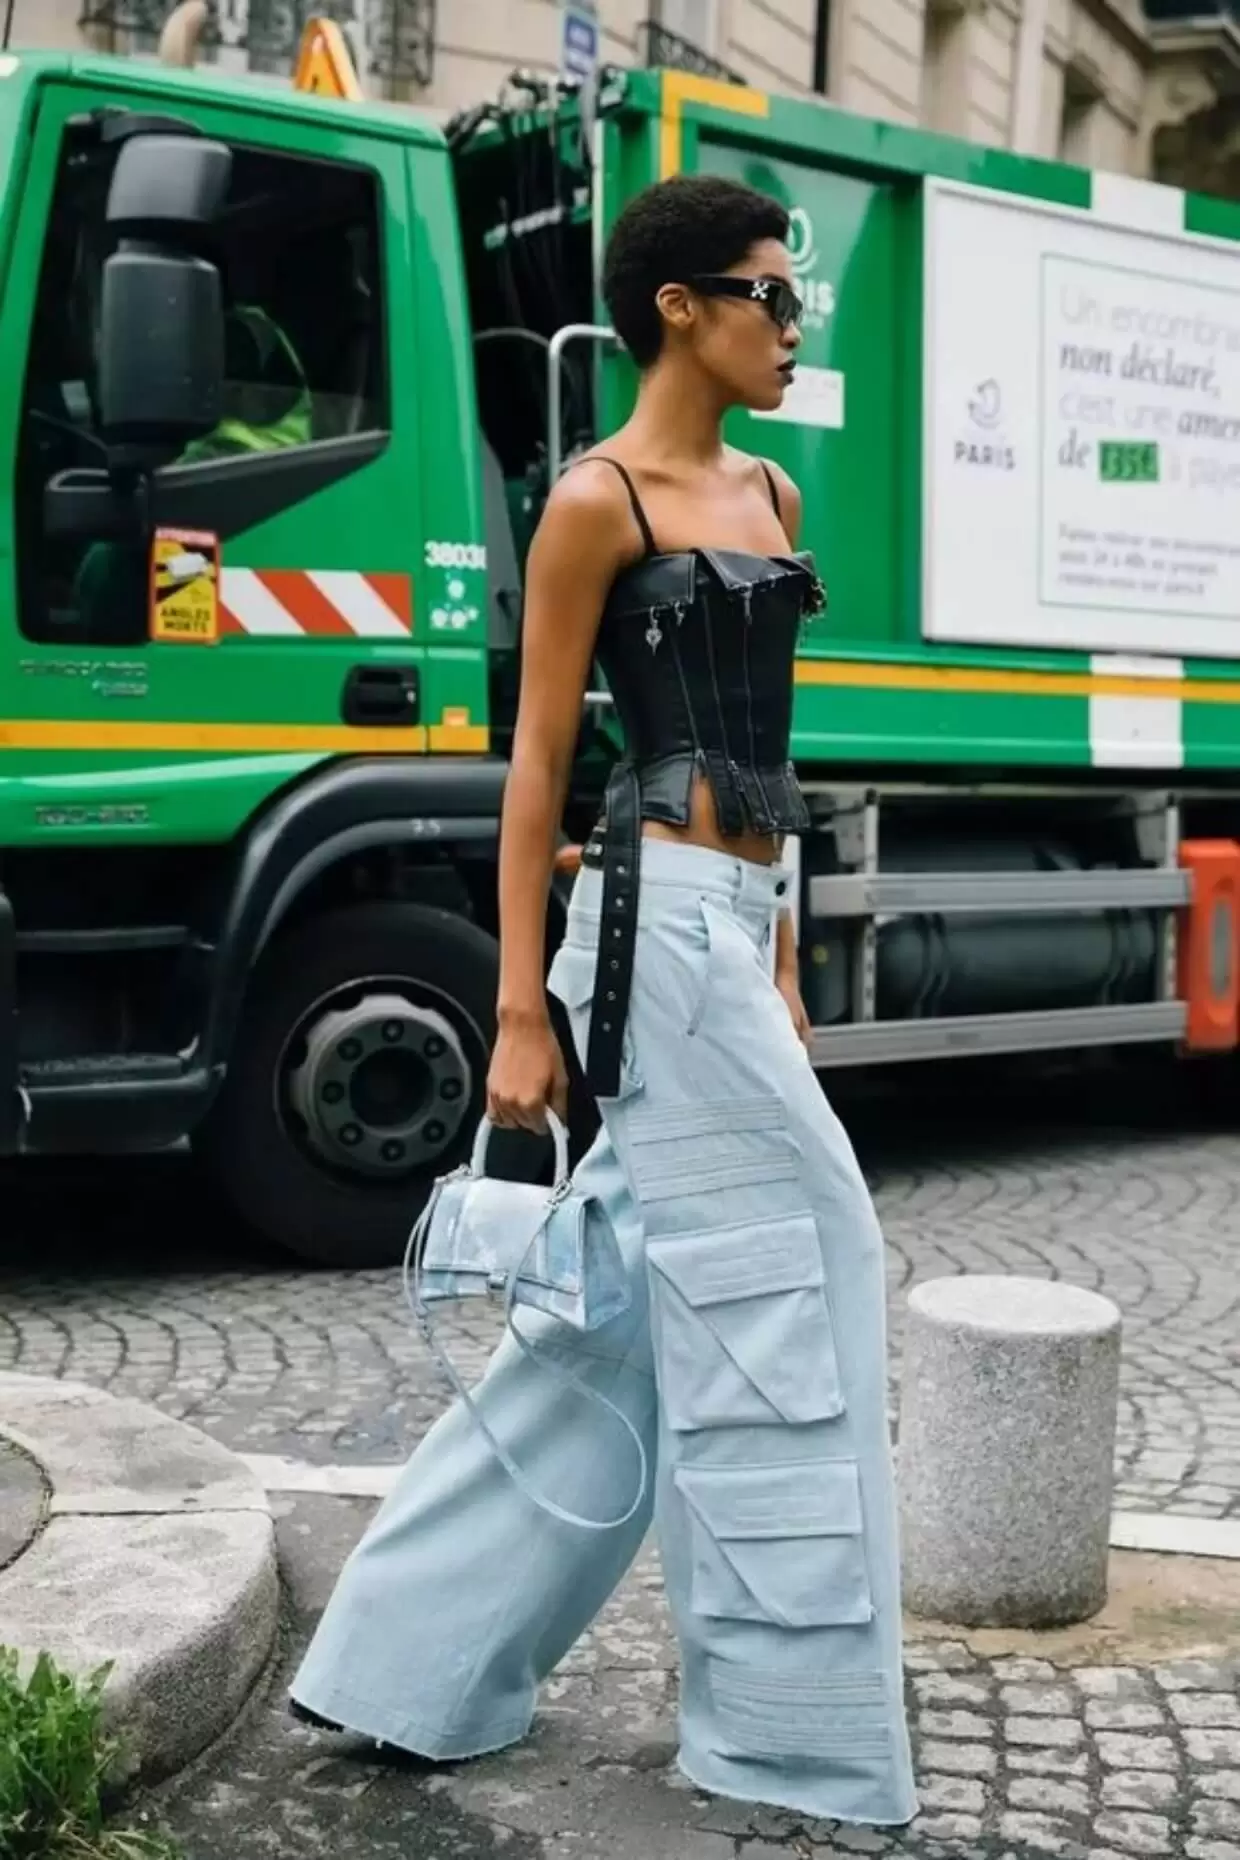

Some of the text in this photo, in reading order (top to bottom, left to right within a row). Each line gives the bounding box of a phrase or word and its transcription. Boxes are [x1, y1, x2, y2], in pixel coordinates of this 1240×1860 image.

[1060, 344, 1113, 376] non
[954, 440, 1017, 471] PARIS
[1058, 427, 1092, 469] de
